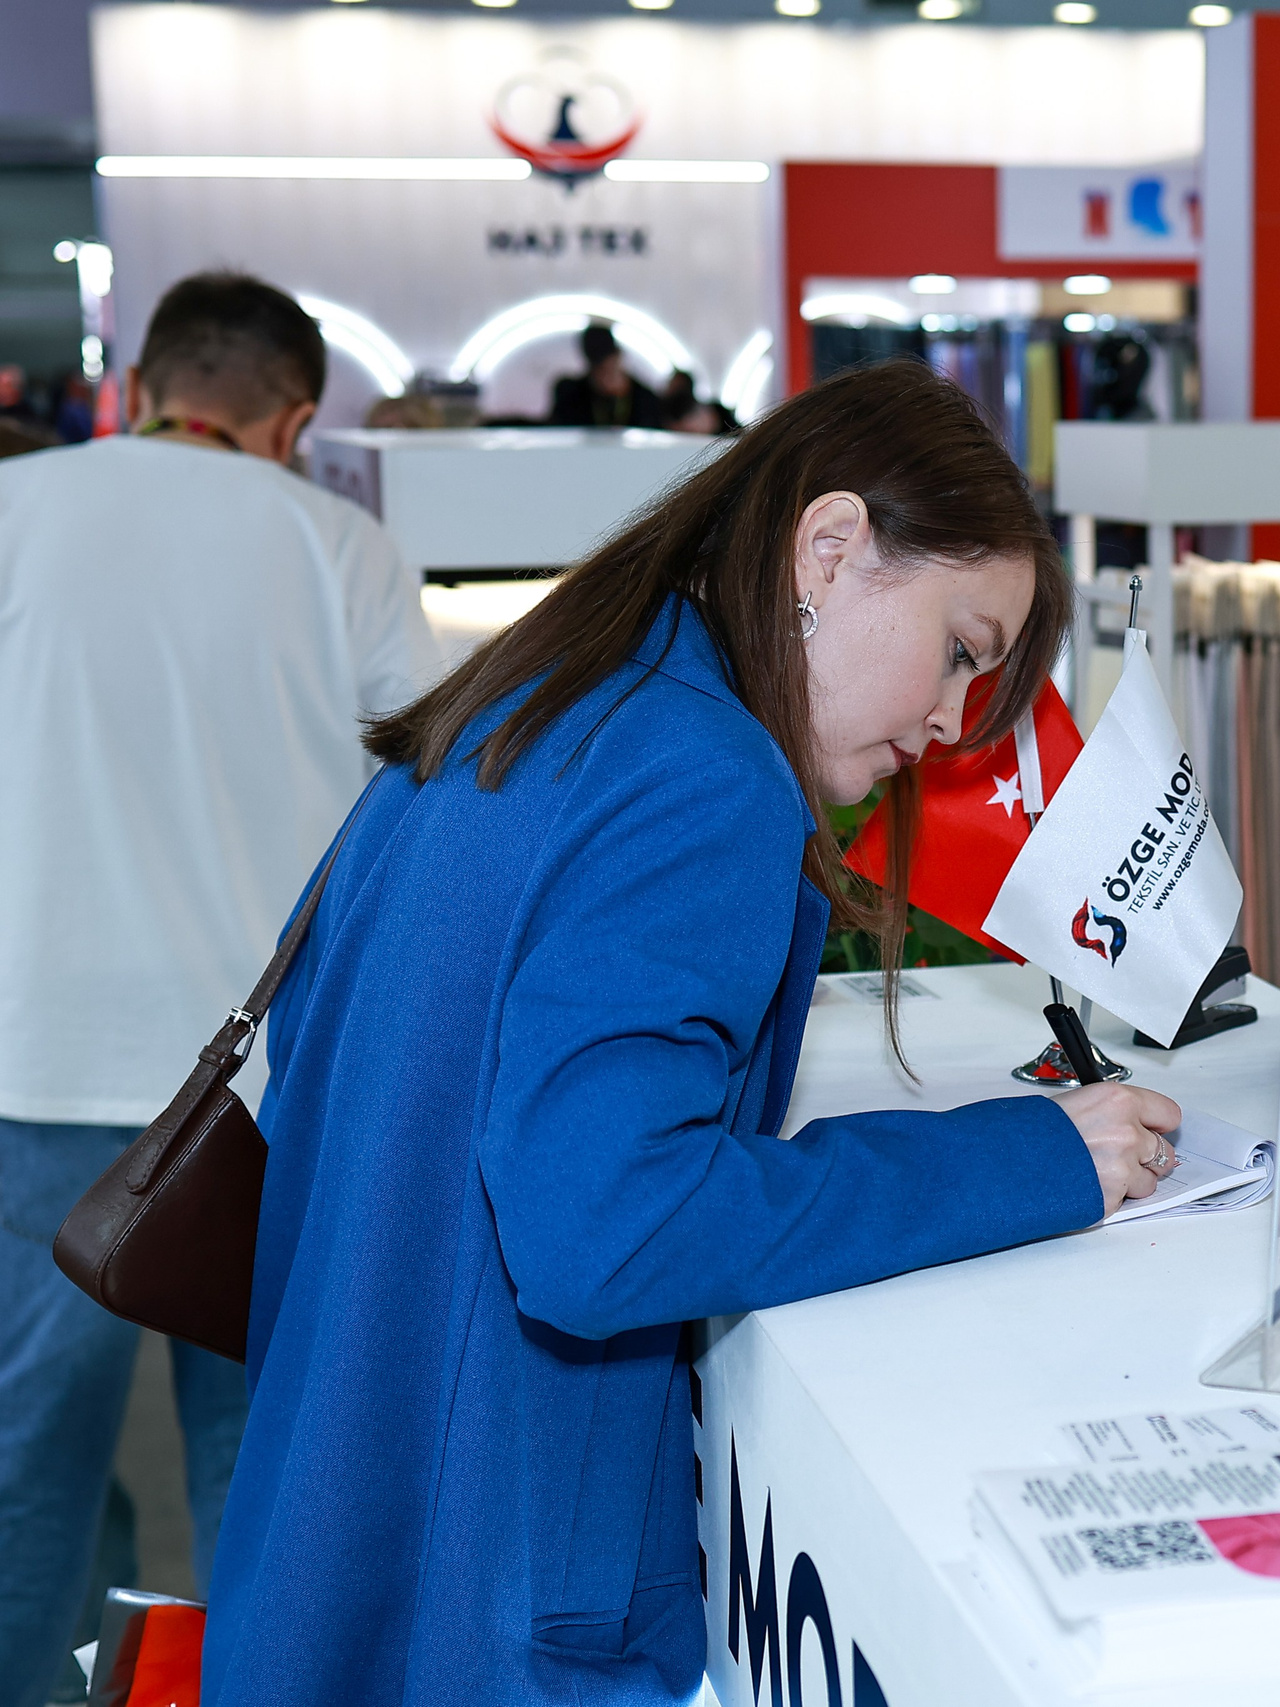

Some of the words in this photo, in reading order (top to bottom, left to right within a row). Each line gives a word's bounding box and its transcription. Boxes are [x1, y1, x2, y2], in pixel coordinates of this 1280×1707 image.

[1102, 822, 1166, 902] ÖZGE
[1126, 869, 1164, 914] TEKSTİL
[1157, 840, 1182, 869] SAN.
[1174, 818, 1191, 837] VE
[727, 1421, 890, 1707] MO
